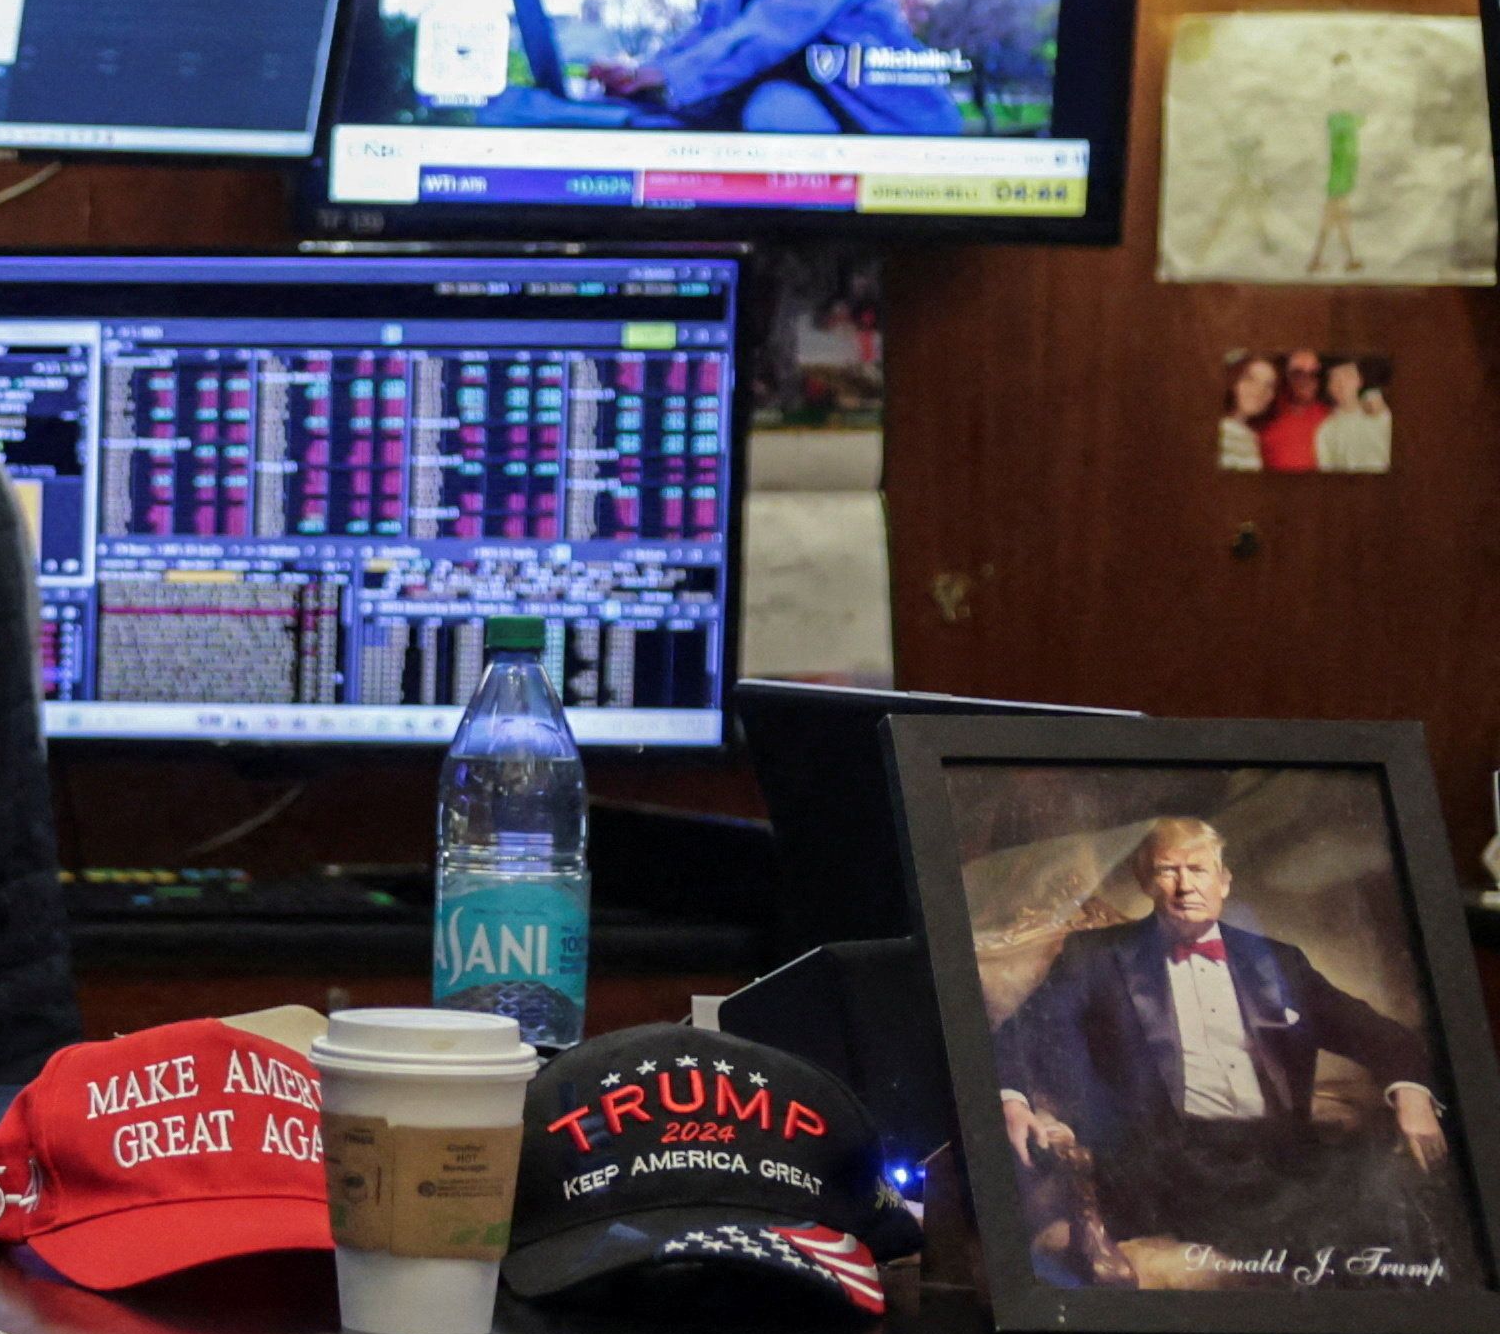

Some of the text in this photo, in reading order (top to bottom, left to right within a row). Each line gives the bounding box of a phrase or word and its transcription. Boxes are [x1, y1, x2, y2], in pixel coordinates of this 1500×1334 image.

[87, 1054, 199, 1119] MAKE
[546, 1067, 829, 1153] TRUMP
[113, 1109, 235, 1168] GREAT
[660, 1121, 736, 1144] 2024
[563, 1149, 824, 1201] KEEP AMERICA GREAT
[1184, 1244, 1445, 1287] Donald J. Trump
